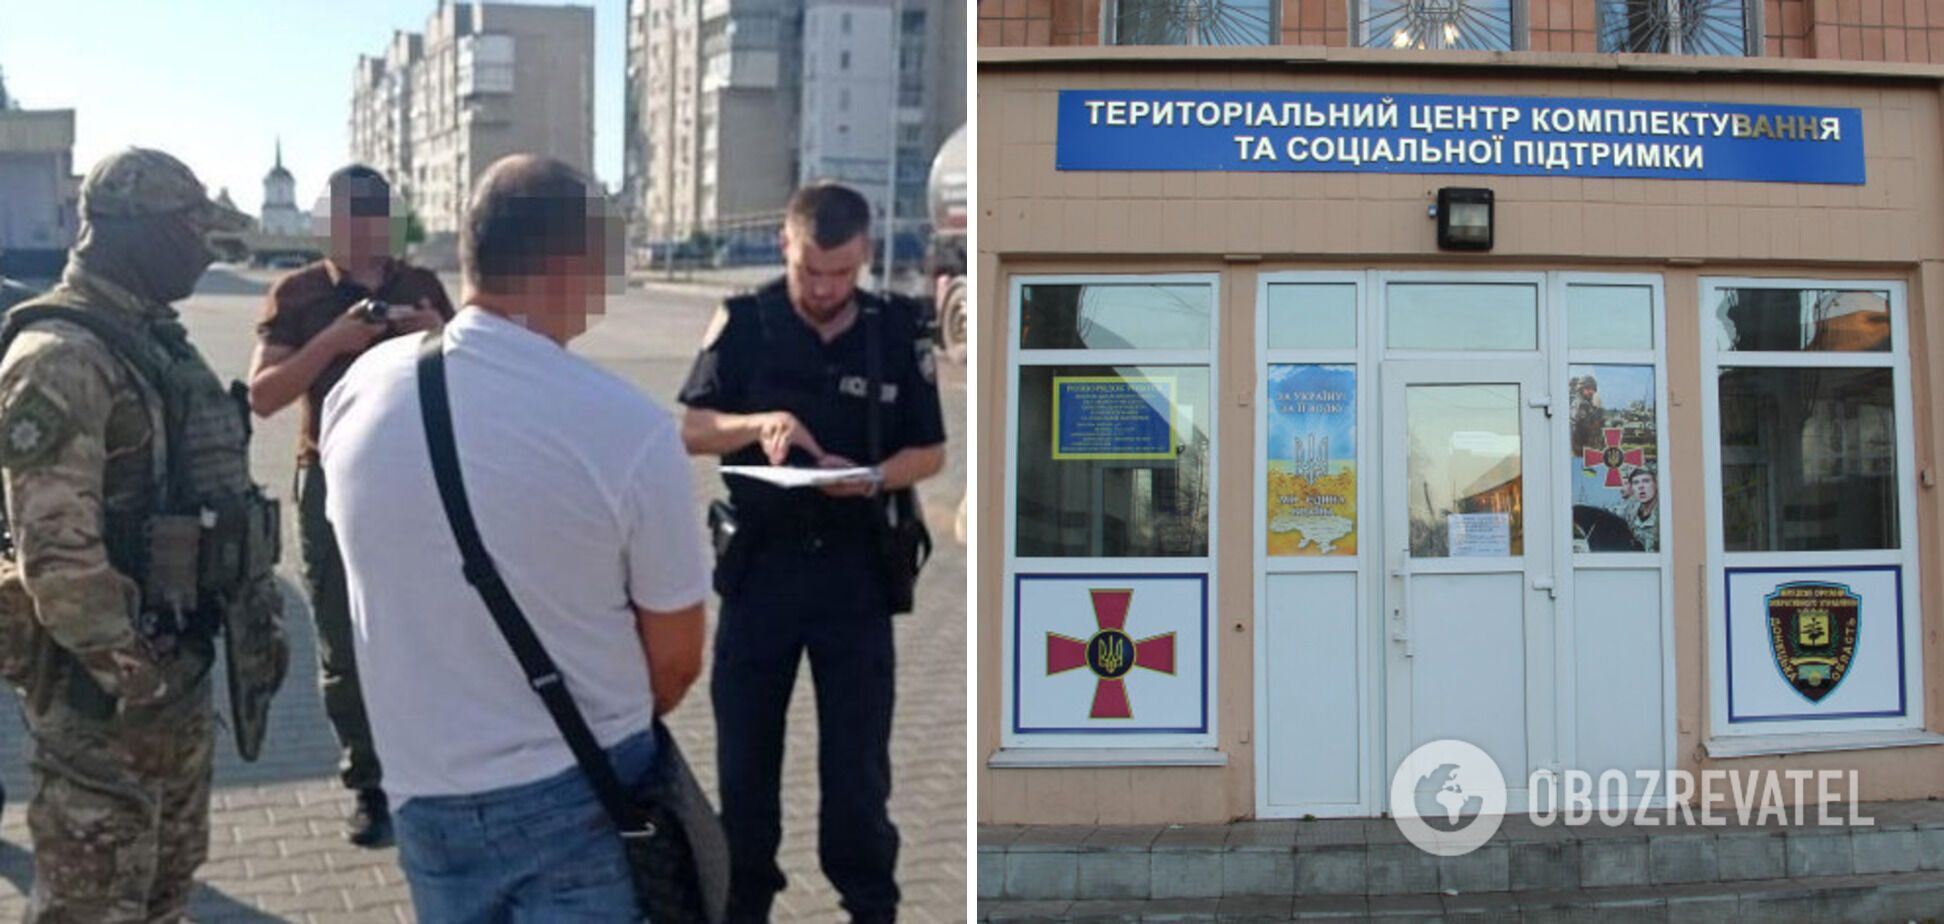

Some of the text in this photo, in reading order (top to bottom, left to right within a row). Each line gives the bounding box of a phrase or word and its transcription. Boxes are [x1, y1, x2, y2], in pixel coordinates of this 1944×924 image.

[1085, 97, 1841, 142] ТЕРИТОРІАЛЬНИЙ ЦЕНТР КОМПЛЕКТУВАННЯ
[1234, 135, 1705, 171] ТА СОЦІАЛЬНОЇ ПІДТРИМКИ
